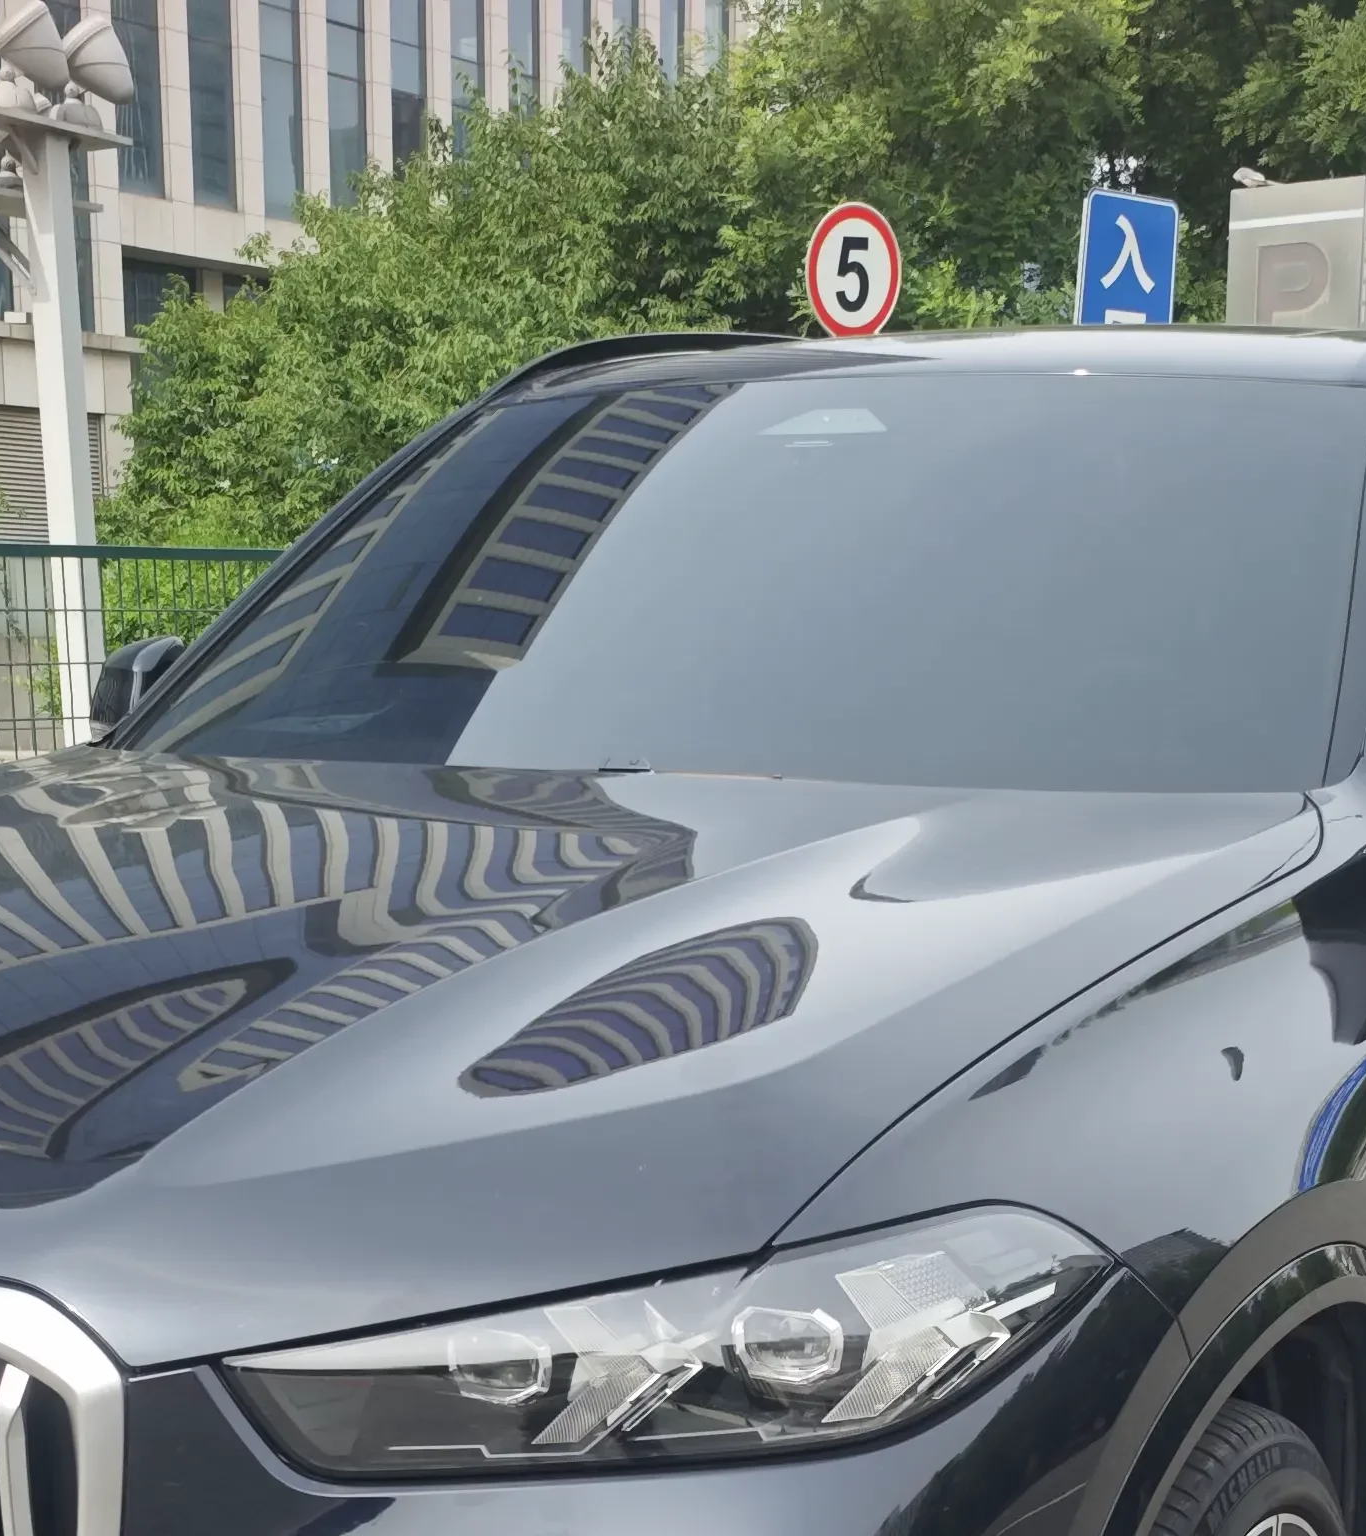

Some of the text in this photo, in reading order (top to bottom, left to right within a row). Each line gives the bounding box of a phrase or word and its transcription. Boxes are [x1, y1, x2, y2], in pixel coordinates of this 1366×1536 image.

[836, 236, 869, 313] 5
[1255, 242, 1330, 325] P
[1206, 1446, 1281, 1535] MICHELIN
